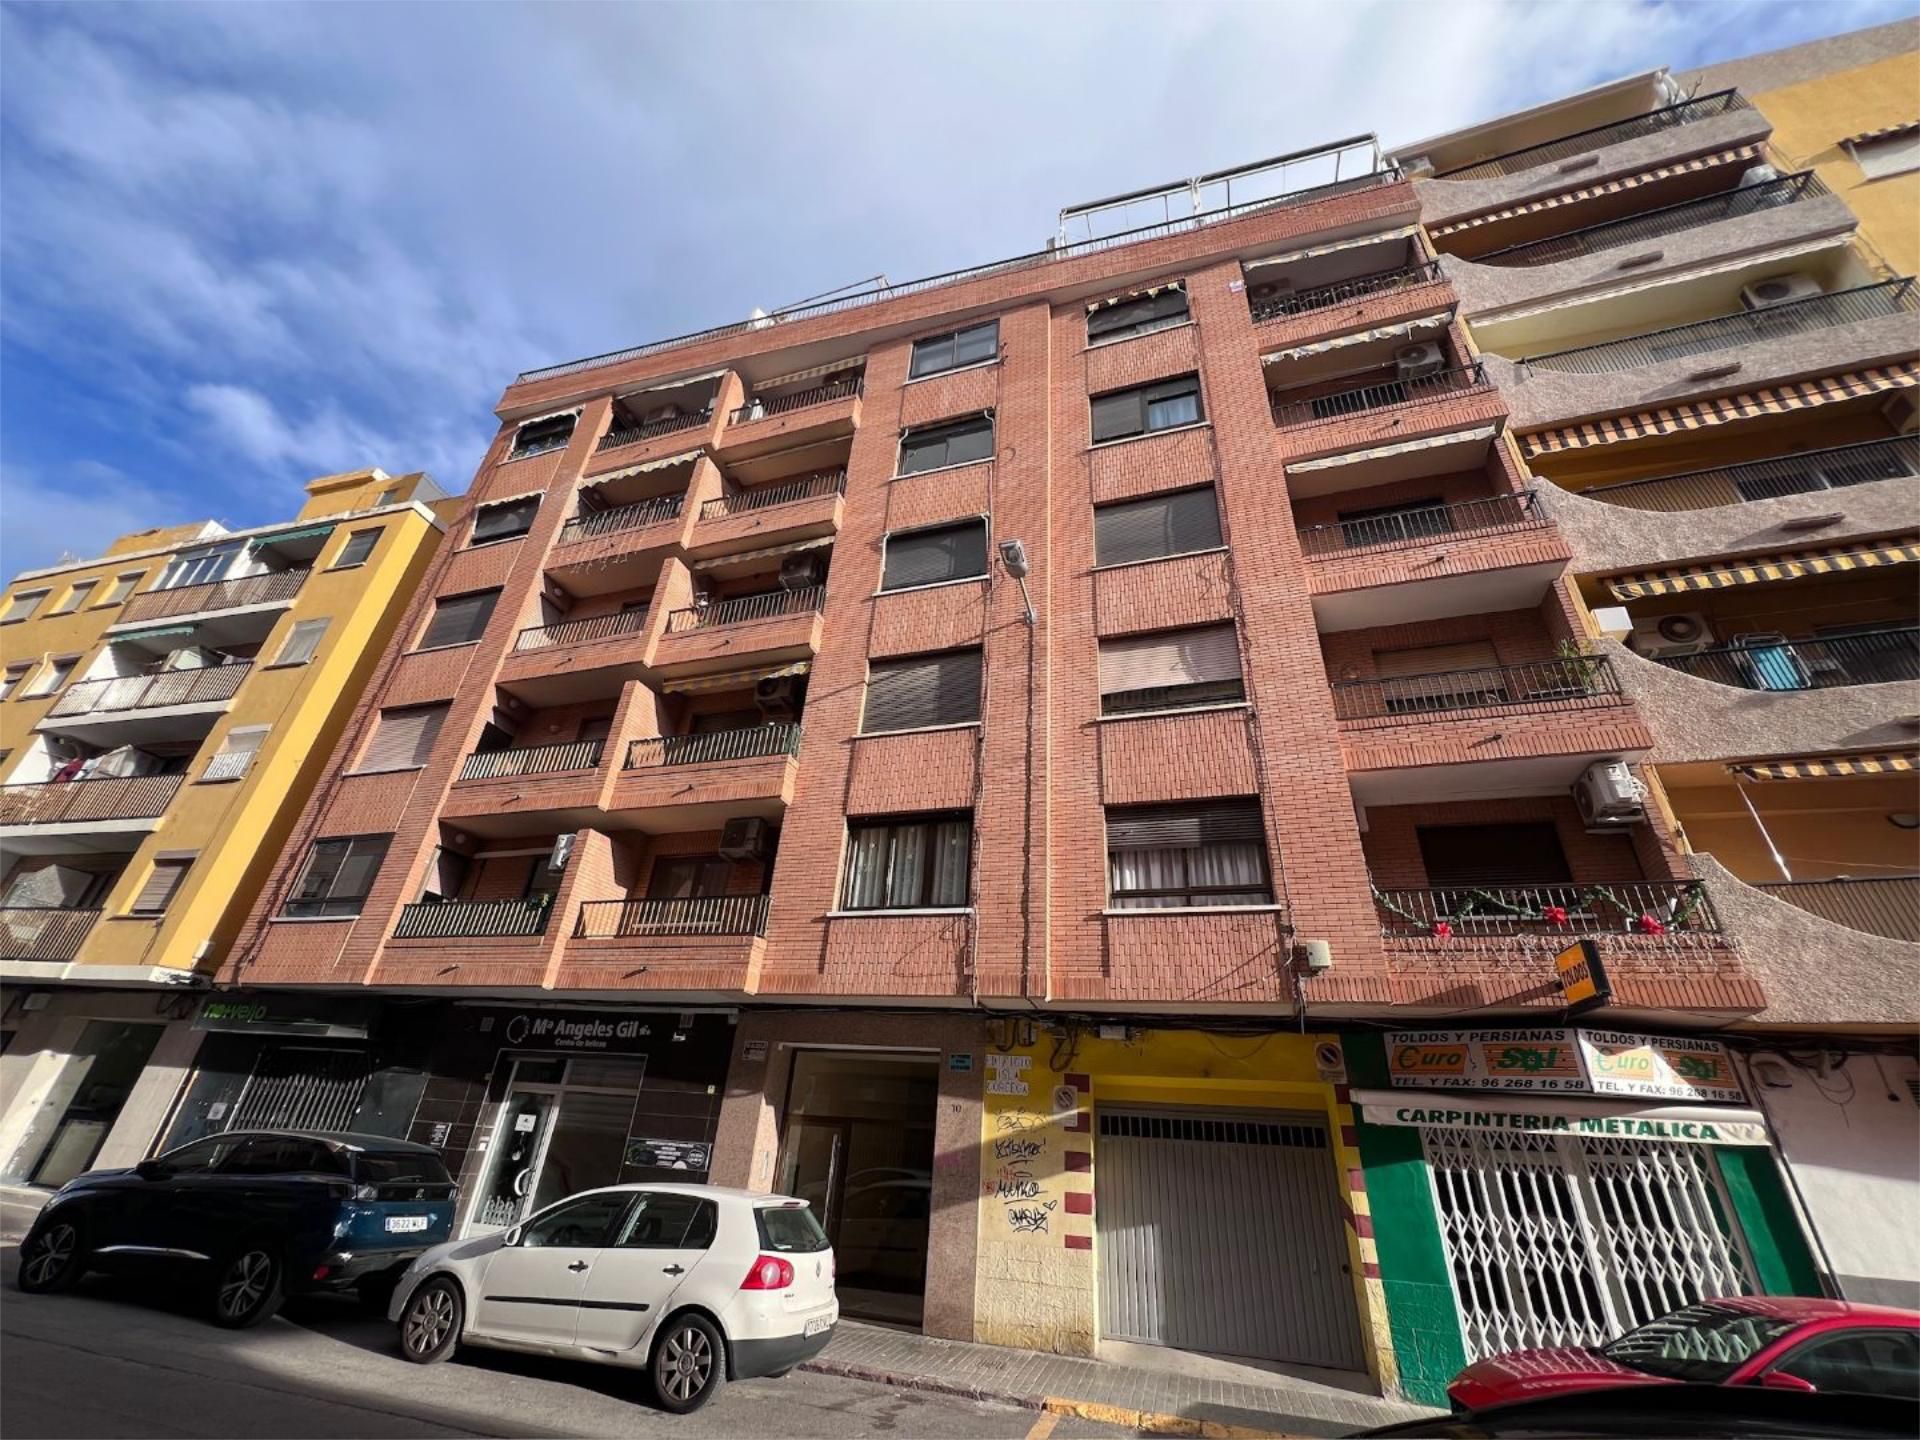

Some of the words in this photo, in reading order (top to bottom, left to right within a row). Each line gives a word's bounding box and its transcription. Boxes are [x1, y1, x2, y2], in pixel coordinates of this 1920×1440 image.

[1561, 960, 1589, 988] TOLDOS
[553, 1019, 614, 1040] Angeles
[616, 1021, 640, 1038] Gil
[1391, 1033, 1449, 1044] TOLDOS
[1454, 1032, 1465, 1042] Y
[1469, 1030, 1566, 1042] PERSIANAS
[1586, 1031, 1635, 1046] TOLDOS
[1639, 1037, 1647, 1047] Y
[1651, 1038, 1719, 1053] PERSIANAS
[1430, 1078, 1439, 1086] Y
[1442, 1078, 1476, 1087] FAX:
[1481, 1079, 1498, 1088] 96
[1504, 1079, 1533, 1089] 268
[1540, 1080, 1558, 1089] 16
[1564, 1080, 1584, 1089] 58
[1598, 1080, 1624, 1092] TEL.
[1628, 1083, 1636, 1092] Y
[1639, 1084, 1666, 1095] FAX:
[1669, 1086, 1683, 1096] 96
[1687, 1088, 1708, 1098] 268
[1713, 1090, 1726, 1099] 16
[1728, 1090, 1743, 1100] 58
[1396, 1108, 1570, 1131] CARPINTERIA
[1579, 1117, 1721, 1140] METALICA
